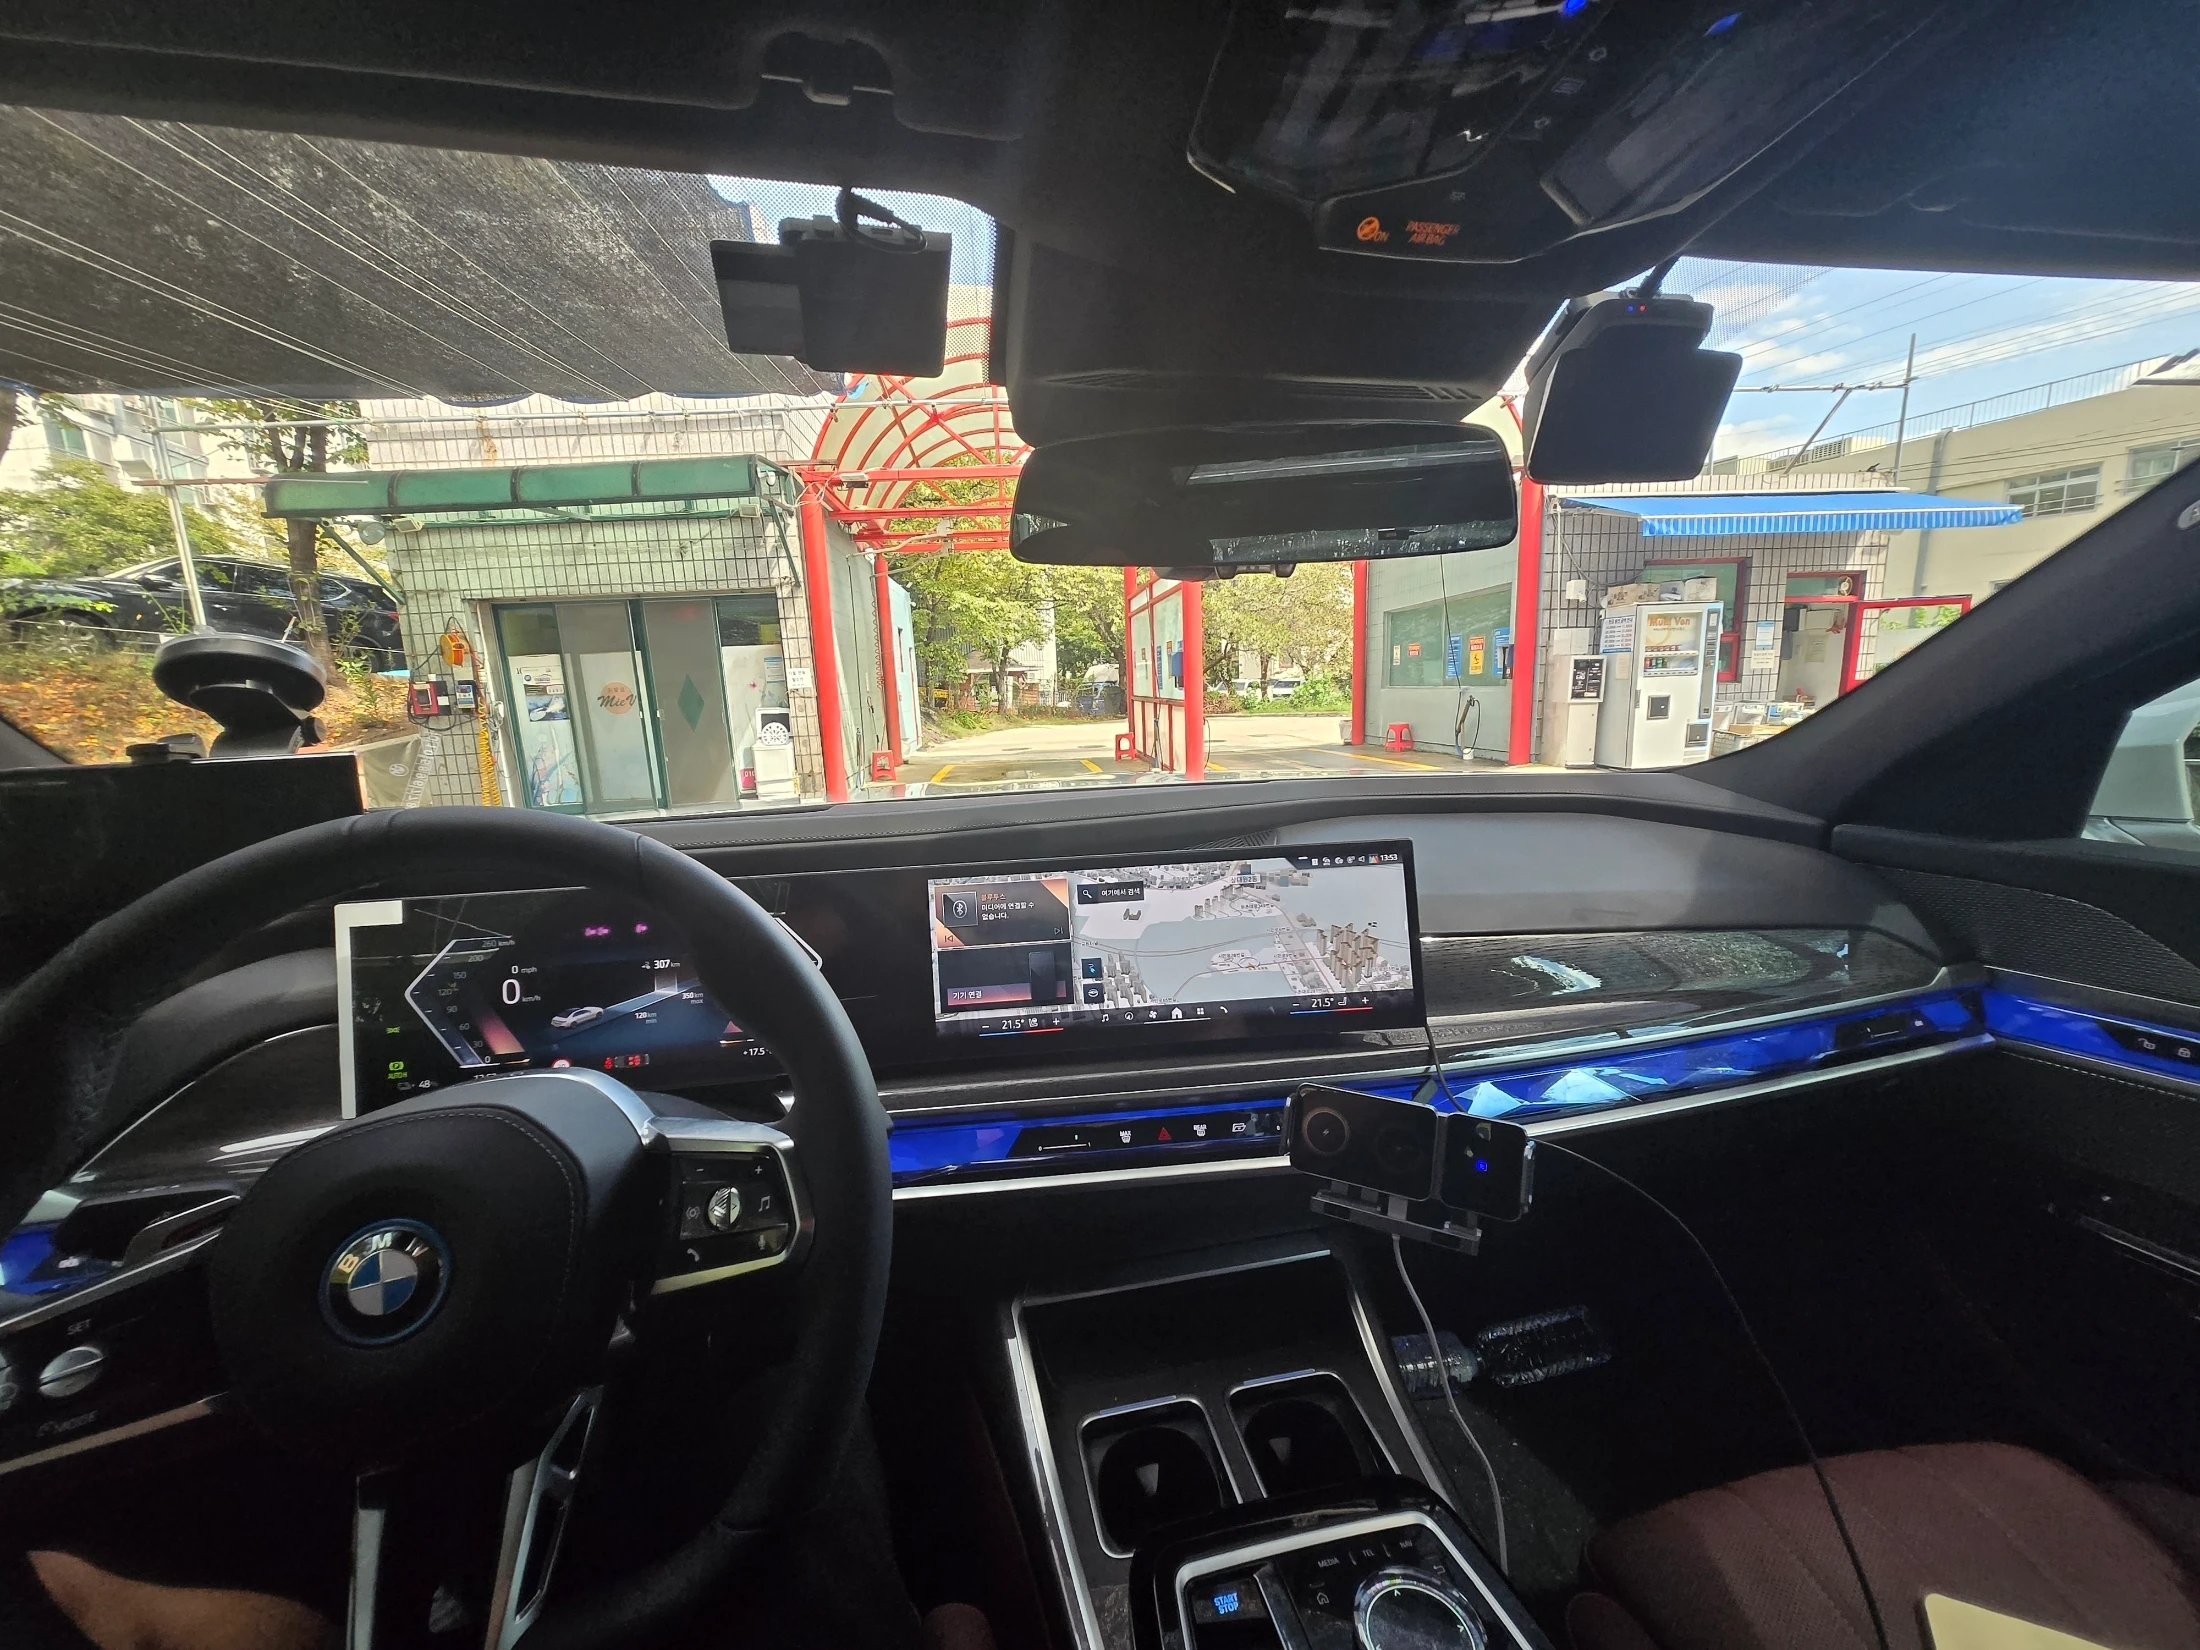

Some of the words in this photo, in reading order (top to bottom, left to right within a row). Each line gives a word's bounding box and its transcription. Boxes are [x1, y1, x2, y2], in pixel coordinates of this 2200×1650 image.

[1379, 853, 1399, 862] 13:53
[1101, 889, 1127, 897] 여기에서
[1128, 887, 1141, 895] 검색
[981, 893, 1006, 902] 블루투스
[981, 903, 1007, 912] 미디어에
[981, 912, 1010, 921] 없습니다.
[481, 940, 497, 948] 260
[468, 954, 484, 963] 200
[653, 959, 671, 970] 307
[511, 965, 519, 974] 0
[453, 971, 467, 979] 150
[502, 978, 521, 1005] 0
[522, 995, 542, 1003] km/h
[682, 992, 694, 1000] 350
[953, 990, 966, 1000] 기기
[968, 989, 982, 999] 연결
[459, 1023, 470, 1031] 60
[473, 1040, 483, 1048] 30
[484, 1055, 492, 1063] 0
[67, 1319, 91, 1335] SET
[1400, 1541, 1413, 1549] NAV
[1362, 1548, 1376, 1557] TEL
[1317, 1557, 1340, 1569] MEDIA
[1214, 1592, 1238, 1607] START
[1218, 1601, 1240, 1615] STOP
